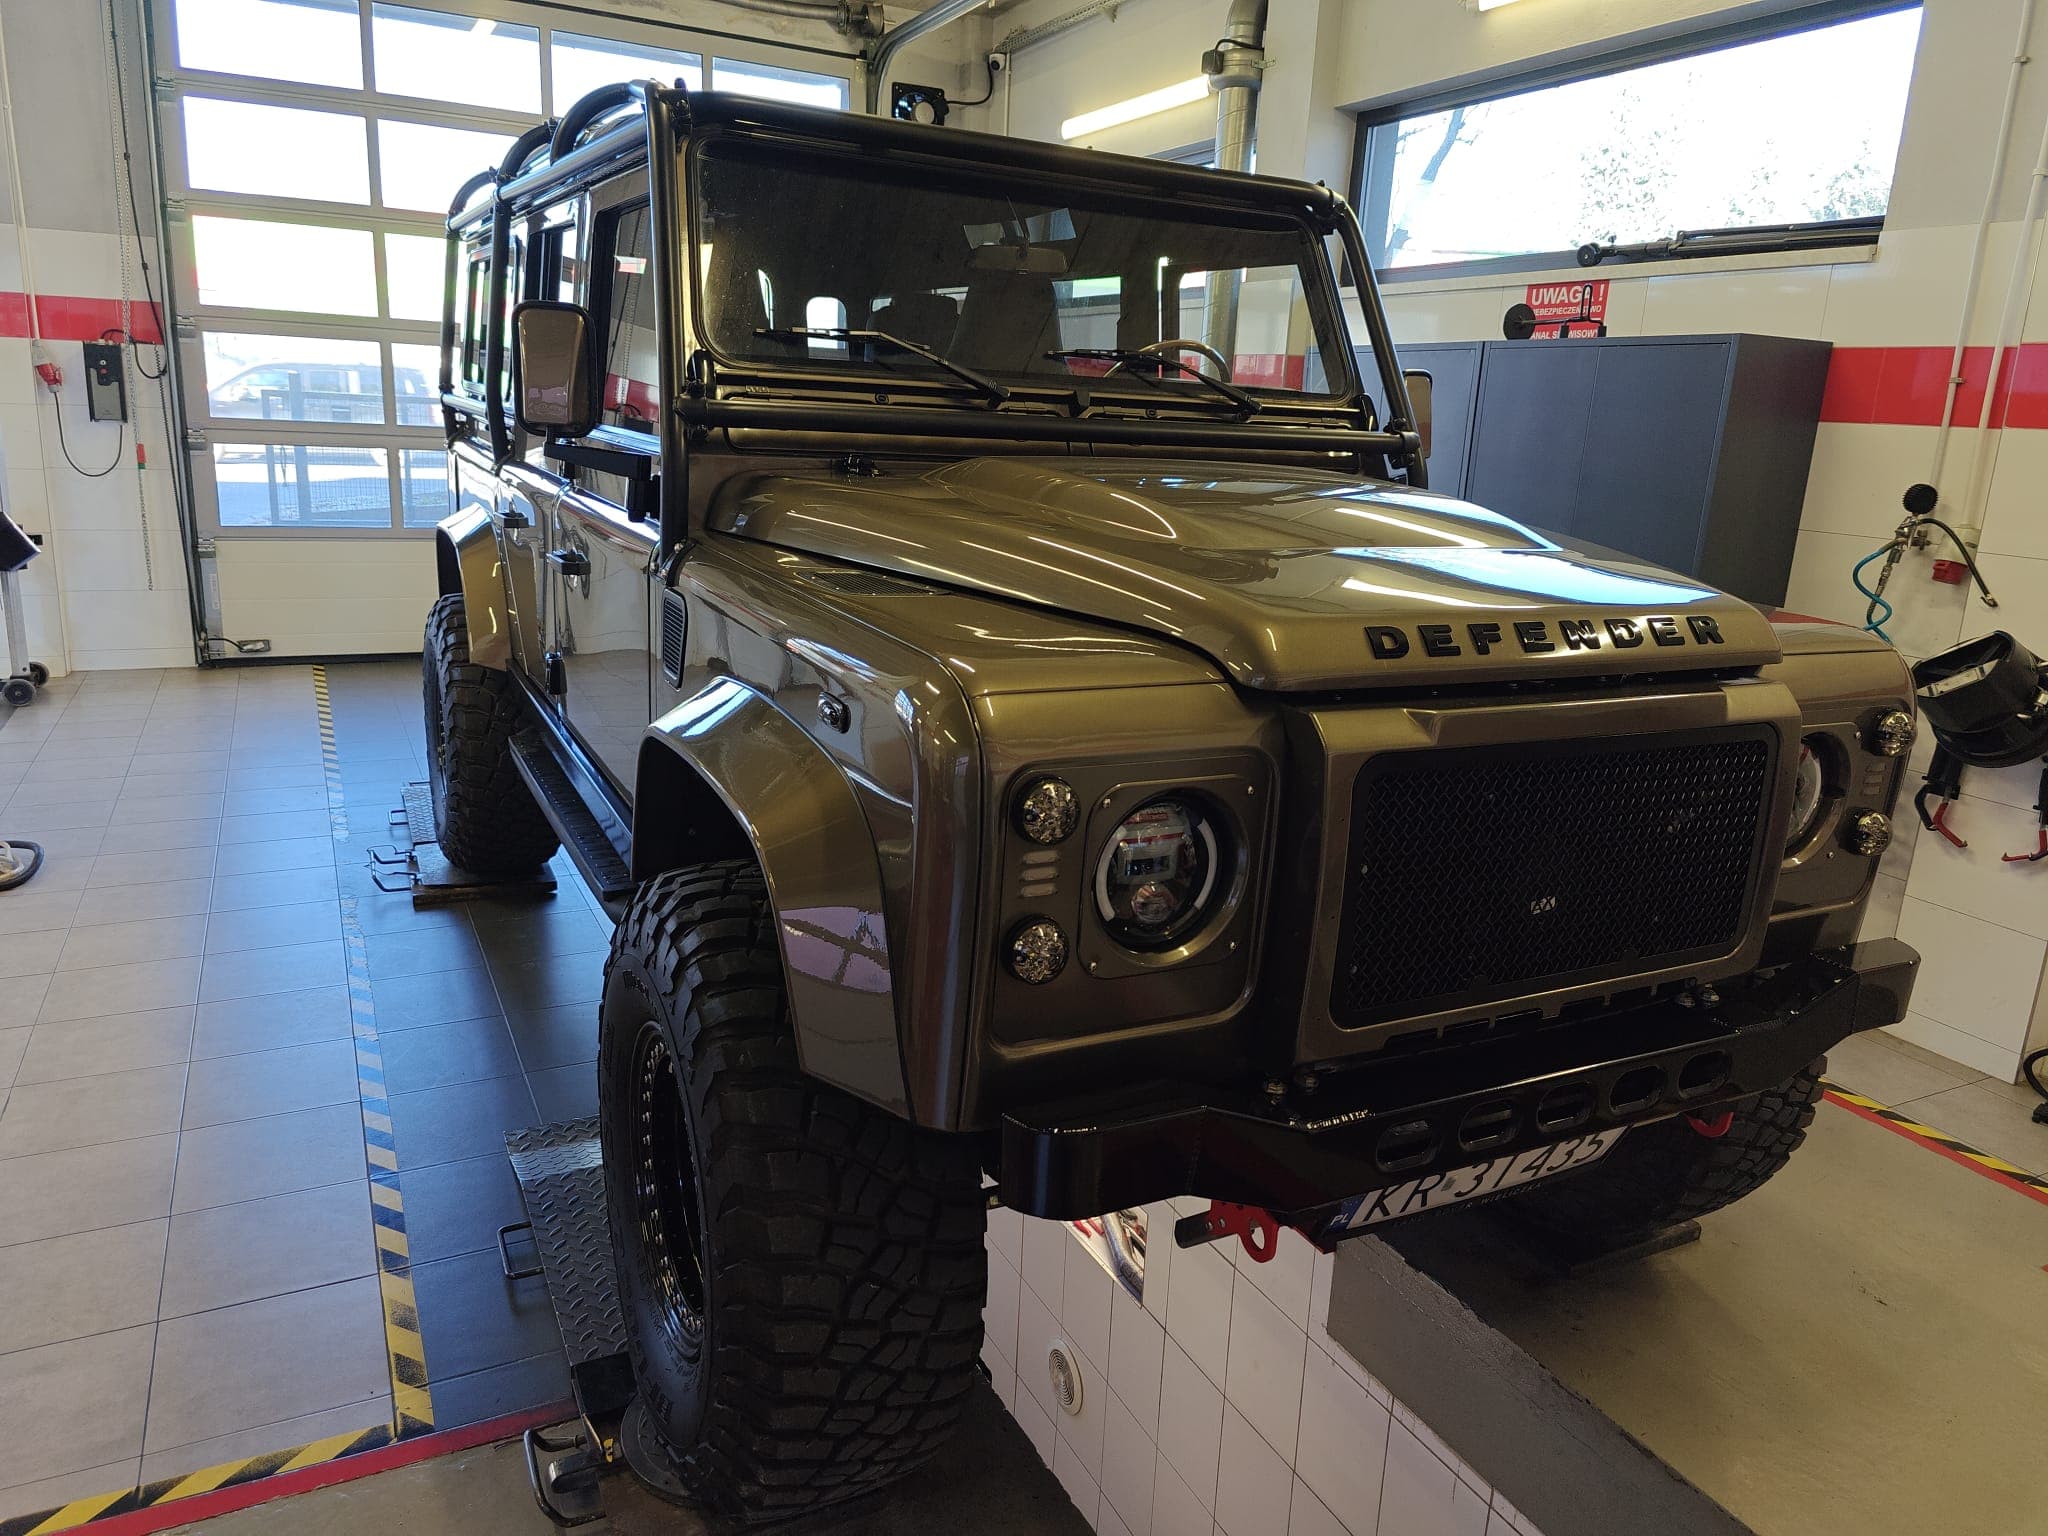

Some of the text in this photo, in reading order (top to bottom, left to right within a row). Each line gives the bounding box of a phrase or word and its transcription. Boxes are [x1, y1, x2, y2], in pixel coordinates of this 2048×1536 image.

[1364, 615, 1725, 660] DEFENDER
[1362, 1134, 1606, 1222] KR 31435
[1330, 1212, 1350, 1226] PL
